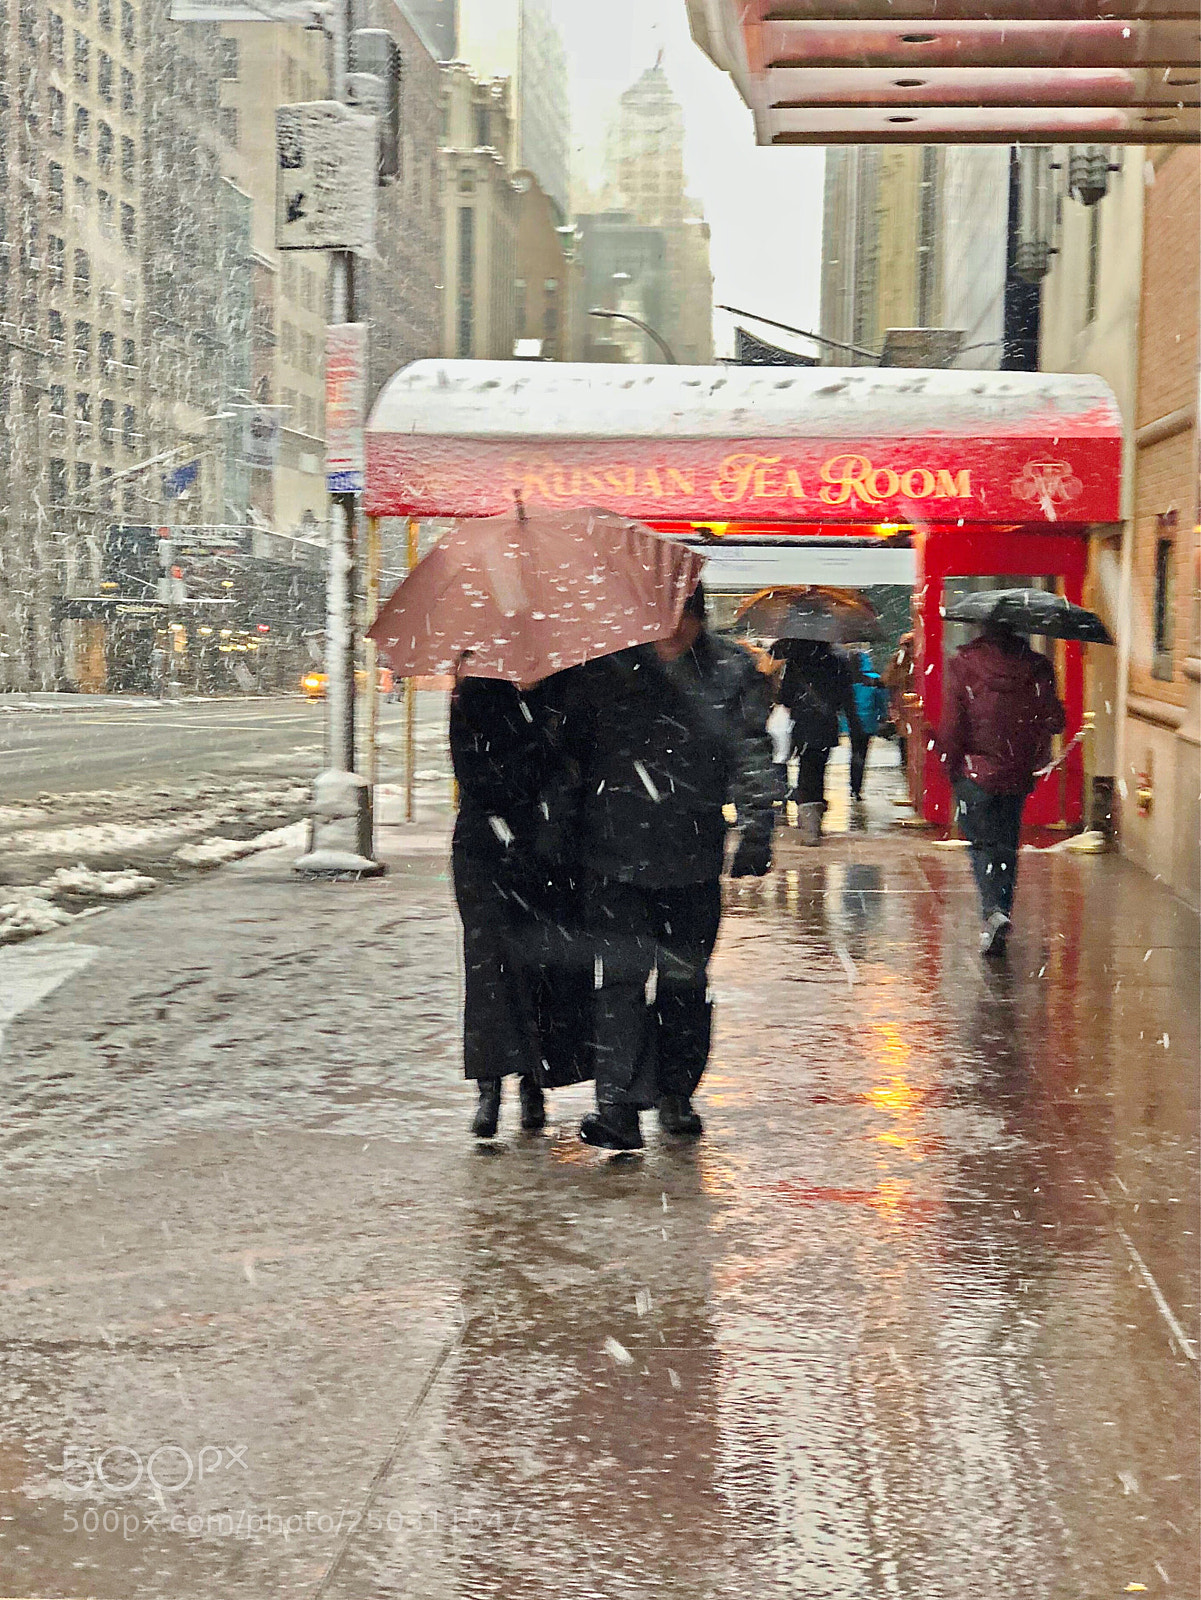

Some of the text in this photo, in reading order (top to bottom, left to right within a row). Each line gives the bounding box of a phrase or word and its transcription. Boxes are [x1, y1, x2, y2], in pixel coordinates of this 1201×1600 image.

[502, 453, 973, 504] RUSSIAN TEA ROOM
